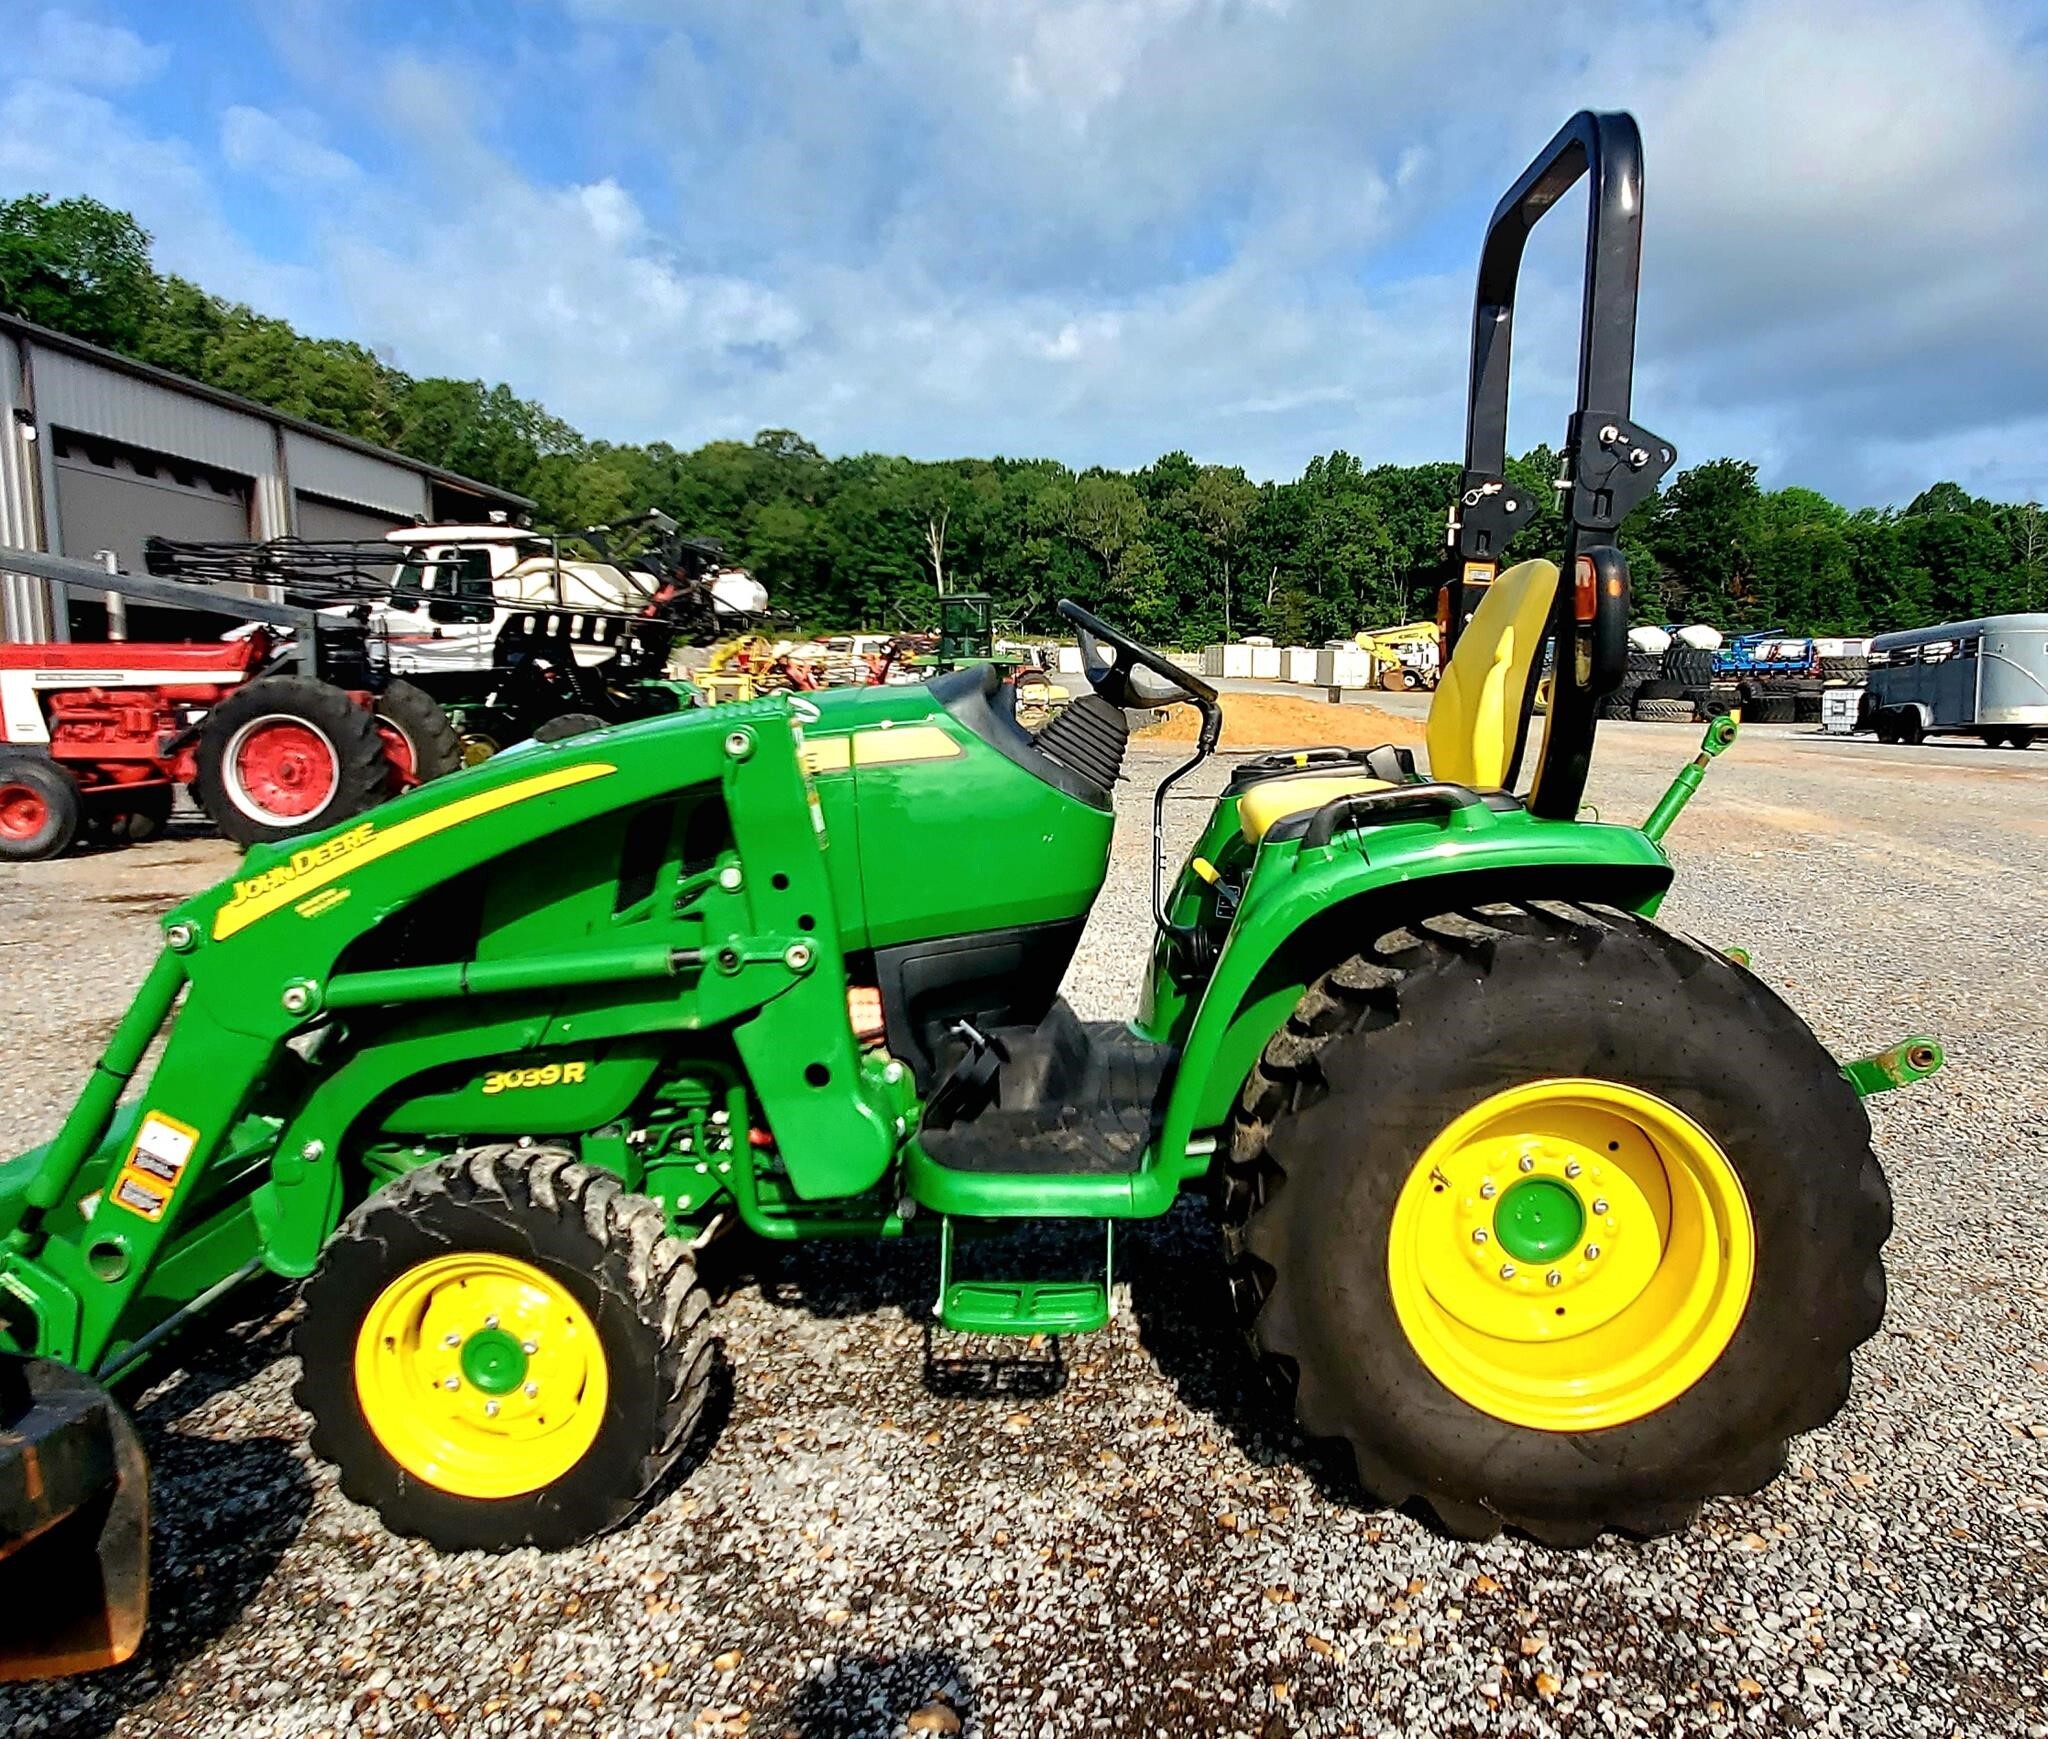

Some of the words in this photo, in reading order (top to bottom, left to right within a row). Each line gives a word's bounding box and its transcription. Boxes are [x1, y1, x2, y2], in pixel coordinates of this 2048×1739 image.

[231, 864, 296, 907] JOHN
[290, 822, 375, 877] DEERE
[482, 1062, 586, 1095] 3039R
